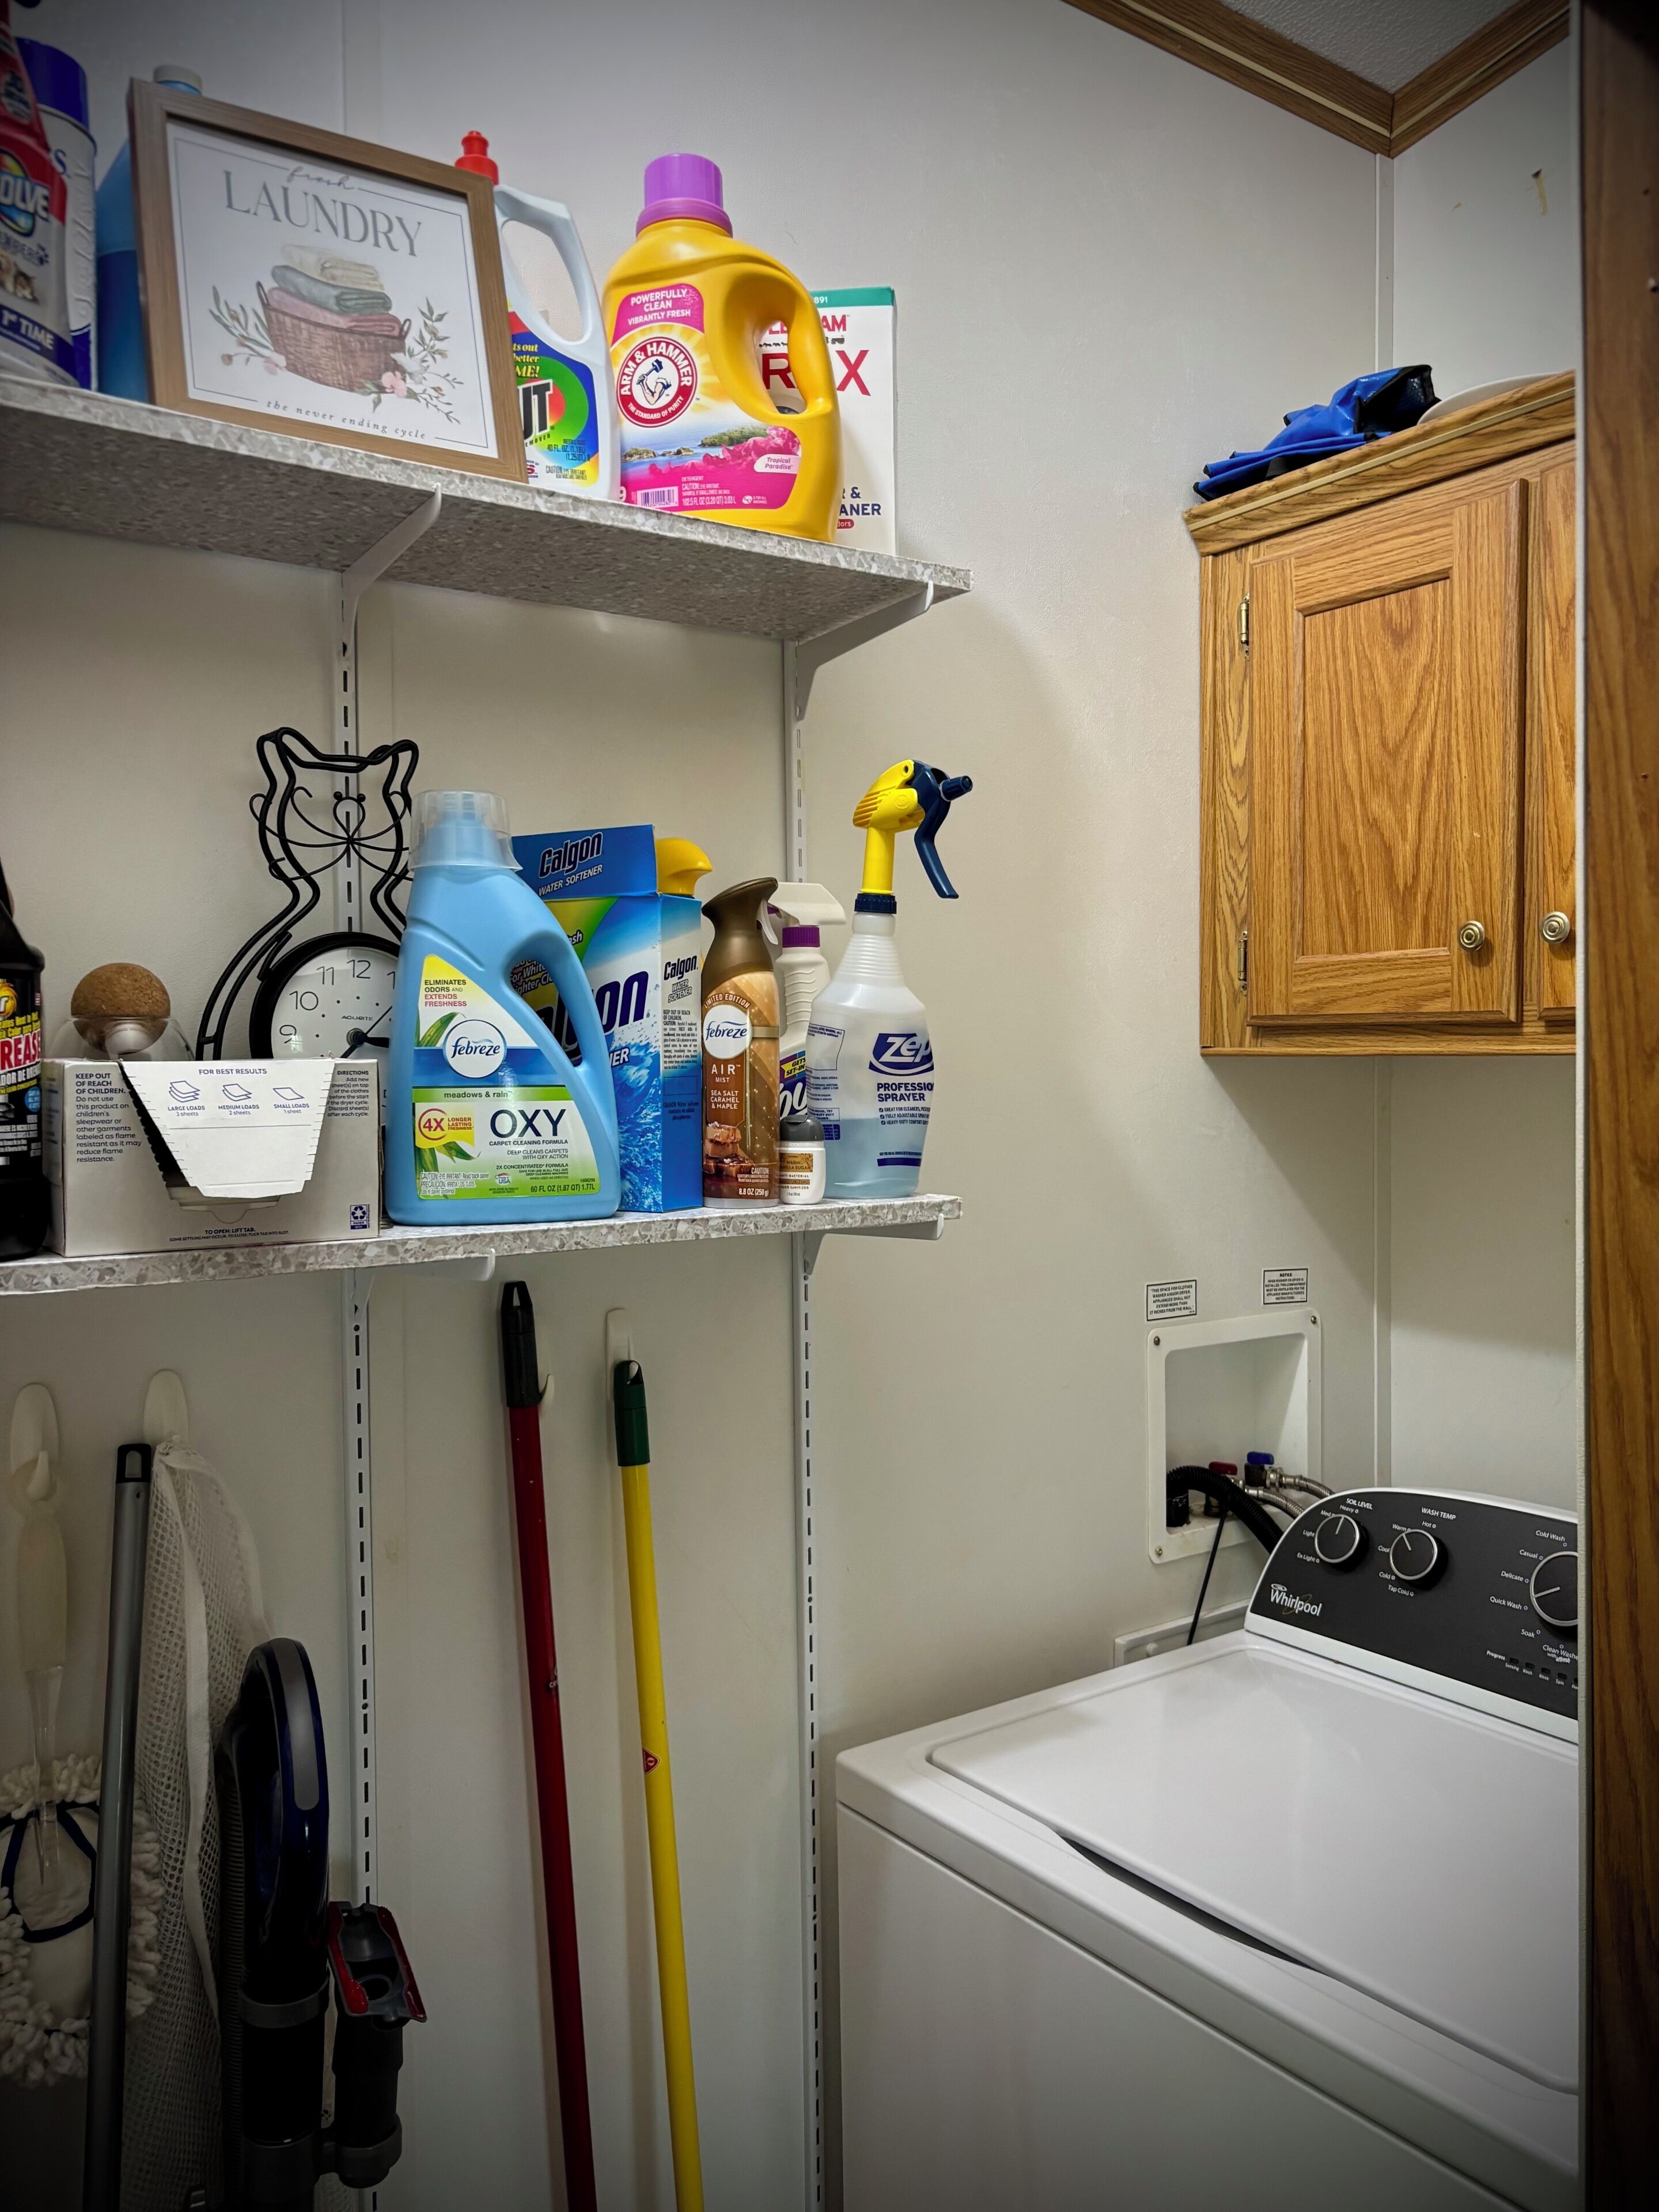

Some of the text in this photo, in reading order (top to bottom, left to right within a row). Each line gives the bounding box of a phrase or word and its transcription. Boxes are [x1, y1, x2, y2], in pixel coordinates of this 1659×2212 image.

[287, 166, 356, 191] fresh
[0, 176, 50, 219] OLVE
[223, 169, 422, 257] LAUNDRY
[631, 289, 688, 306] POWERFULLY
[643, 300, 672, 313] CLEAN
[628, 309, 691, 326] VIBRANTLY FRESH
[516, 365, 540, 378] ME!
[621, 342, 692, 396] ARM & HAMMER
[635, 409, 661, 420] STANDARD
[661, 409, 668, 418] OF
[668, 396, 684, 413] PURITY
[267, 400, 426, 440] the never ending cycle
[525, 433, 551, 447] EMOVER
[839, 504, 881, 516] ANER
[539, 832, 603, 878] Calgon
[539, 864, 603, 896] WATER SOFTENER
[347, 959, 371, 979] 12
[664, 955, 697, 980] Calgon
[316, 966, 334, 986] 11
[387, 971, 395, 990] 1
[289, 991, 319, 1010] 10
[704, 993, 751, 1009] LIMITED EDITION
[279, 1024, 297, 1044] 9
[706, 1021, 747, 1041] febreze
[451, 1036, 500, 1059] febreze
[711, 1064, 736, 1075] AIR
[786, 1064, 805, 1075] SET-IN
[792, 1058, 806, 1067] GETS
[877, 1082, 934, 1092] PROFESSIO
[877, 1093, 925, 1103] SPRAYER
[423, 1118, 445, 1131] 4X
[490, 1109, 566, 1138] OXY
[571, 1184, 580, 1192] QT)
[764, 1189, 769, 1197] g)
[1339, 1505, 1354, 1513] Heavy
[1346, 1498, 1373, 1510] SOIL LEVEL
[1421, 1507, 1456, 1521] WASH TEMP
[1303, 1529, 1315, 1537] Light
[1536, 1530, 1565, 1542] Cold Wash
[1303, 1554, 1316, 1563] Light
[1520, 1549, 1537, 1559] Casual
[1379, 1571, 1391, 1580] Cold
[1501, 1570, 1524, 1582] Delicate
[1388, 1585, 1410, 1596] Tap Cold
[1270, 1588, 1323, 1616] Whirlpool
[1490, 1596, 1522, 1610] Quick Wash
[1521, 1629, 1535, 1638] Soak
[1486, 1650, 1505, 1661] Progress
[1543, 1645, 1578, 1660] Clean Washe
